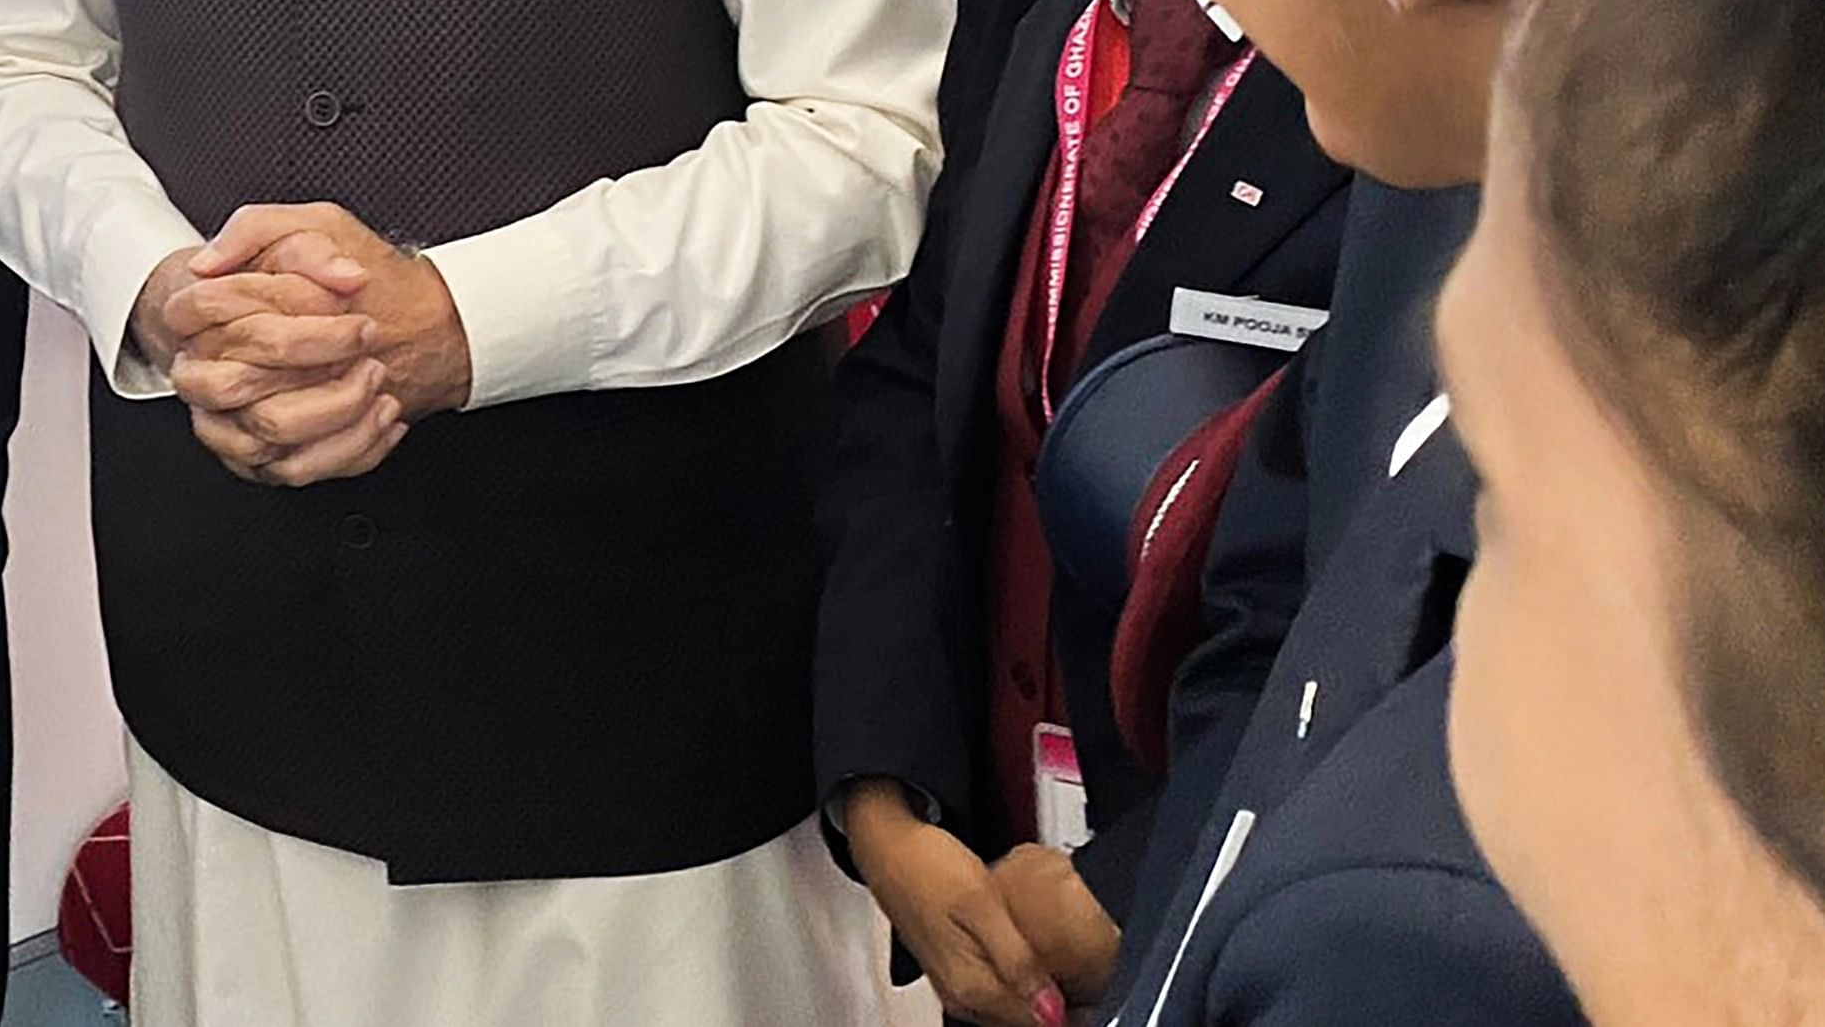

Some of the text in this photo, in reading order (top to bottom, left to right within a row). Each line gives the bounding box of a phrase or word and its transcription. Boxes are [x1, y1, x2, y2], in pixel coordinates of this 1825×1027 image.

[1063, 84, 1082, 115] OF
[1204, 311, 1229, 325] KM
[1233, 316, 1292, 336] POOJA
